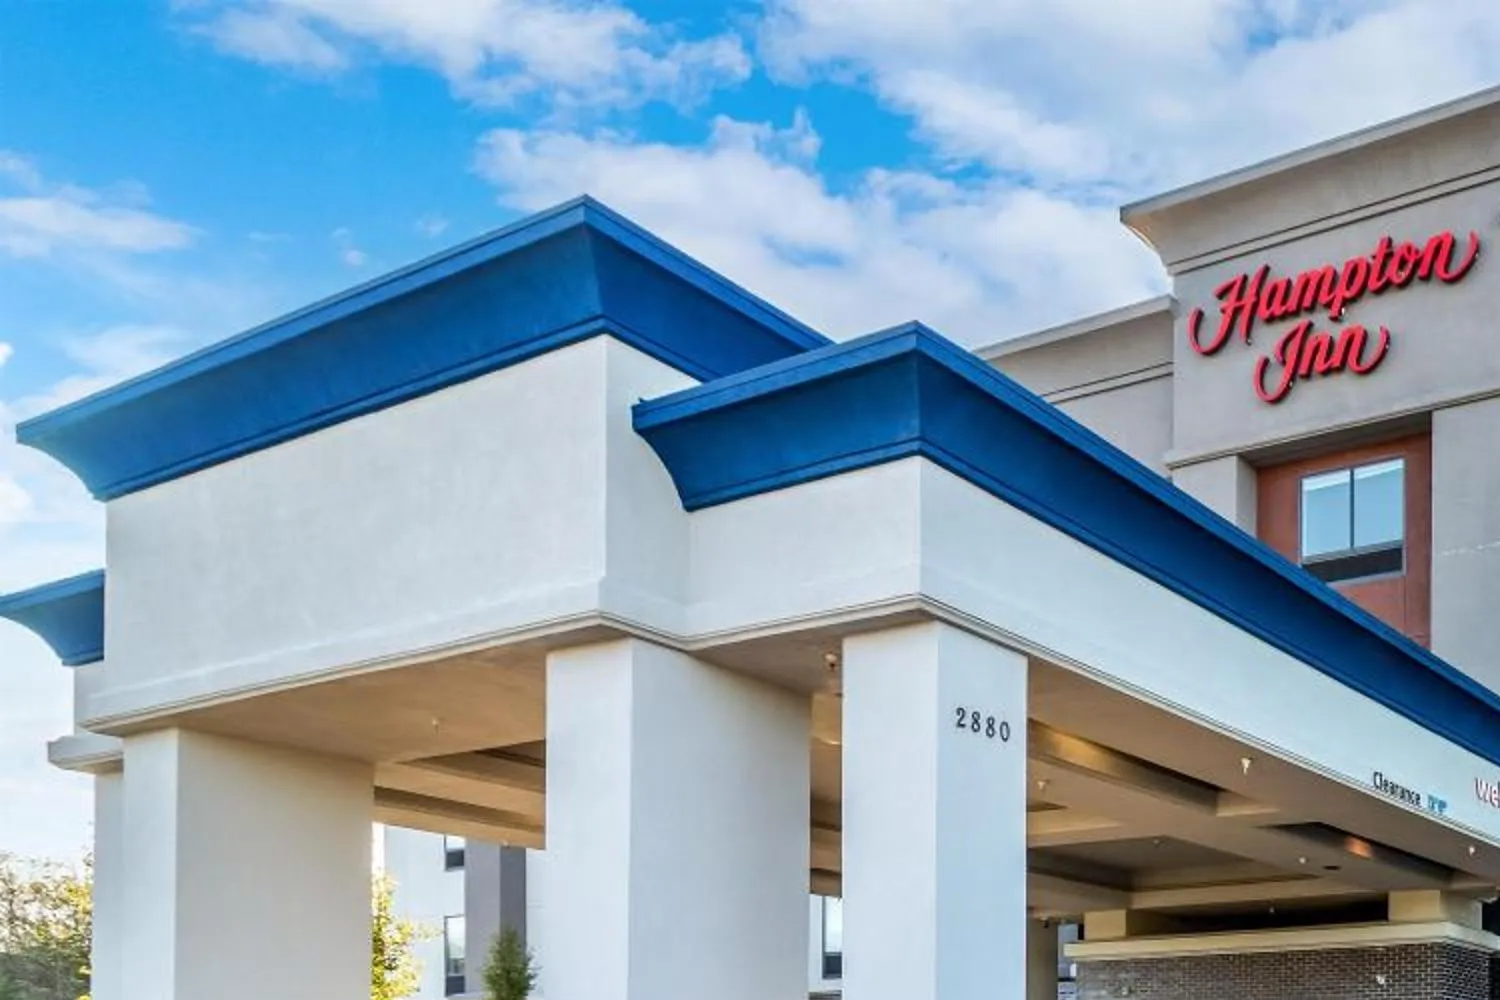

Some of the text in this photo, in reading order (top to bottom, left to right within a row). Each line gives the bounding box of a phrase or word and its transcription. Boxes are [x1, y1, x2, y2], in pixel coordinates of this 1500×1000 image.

[1188, 230, 1479, 355] Hampton
[1253, 319, 1390, 404] Inn
[955, 707, 1010, 742] 2880
[1373, 771, 1421, 806] Clearance
